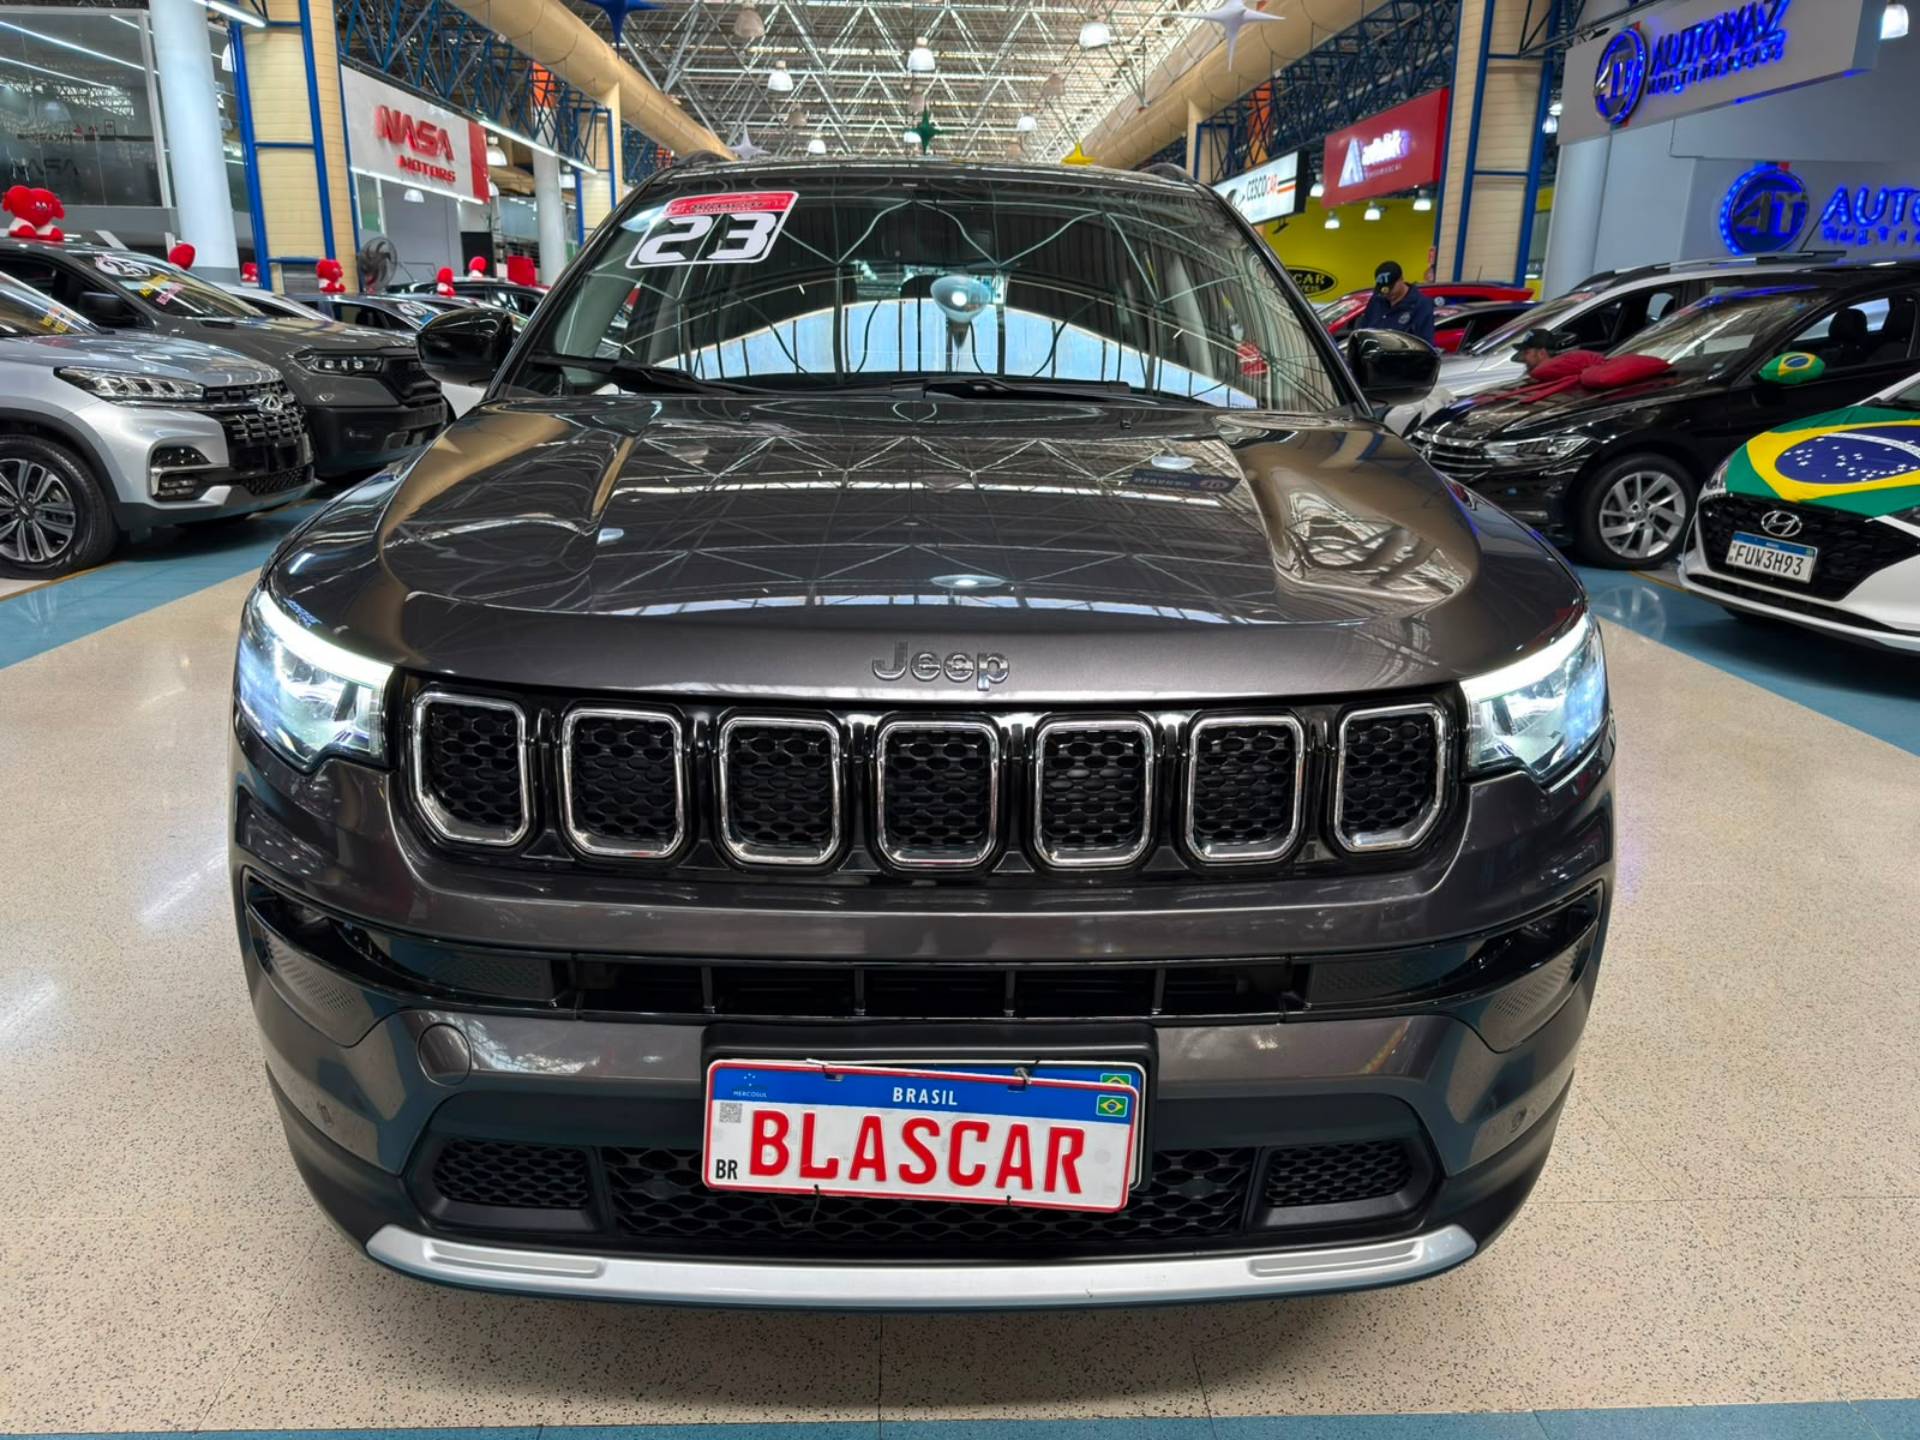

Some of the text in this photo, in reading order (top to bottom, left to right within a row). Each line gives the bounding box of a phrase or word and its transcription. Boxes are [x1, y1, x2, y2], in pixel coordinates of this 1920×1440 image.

[375, 105, 455, 161] NASA
[397, 154, 456, 182] MOTORS
[637, 212, 777, 264] 23
[1734, 544, 1804, 576] FUW3H93
[872, 641, 1010, 692] Jeep
[892, 1086, 958, 1106] BRASIL
[715, 1158, 739, 1181] BR
[749, 1109, 1085, 1194] BLASCAR
